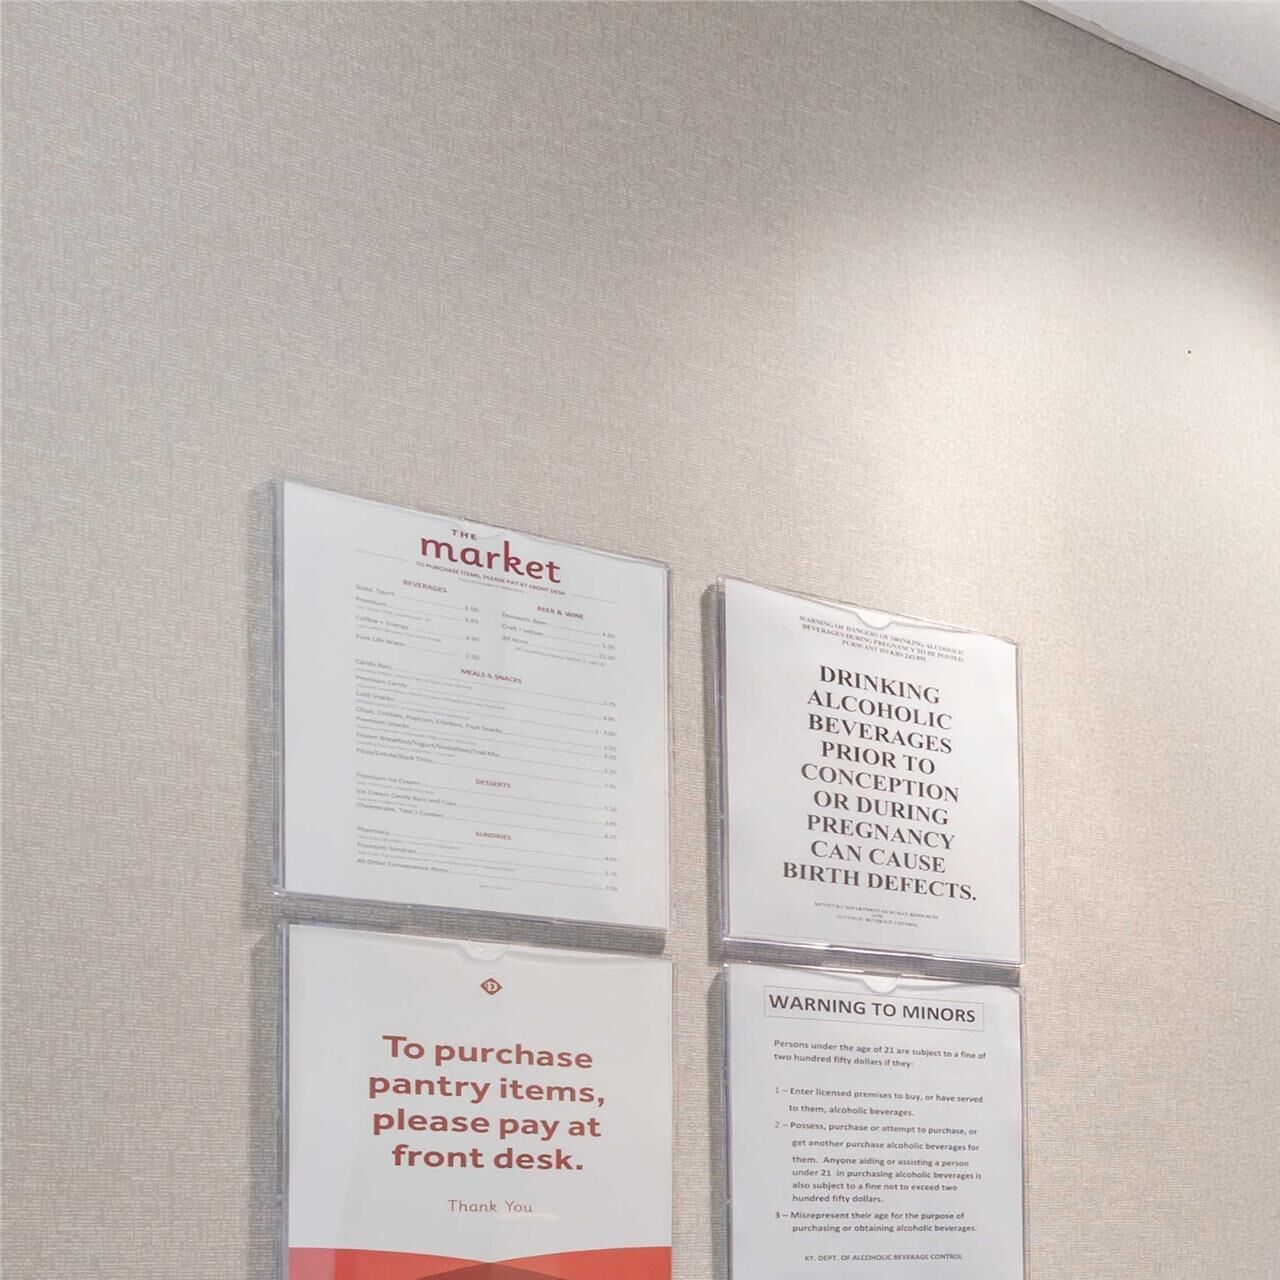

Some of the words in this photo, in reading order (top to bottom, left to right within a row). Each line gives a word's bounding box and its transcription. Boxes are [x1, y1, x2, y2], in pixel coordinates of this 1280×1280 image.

[451, 529, 478, 540] THE
[421, 538, 561, 583] market
[403, 579, 447, 593] BEVERAGES
[461, 669, 485, 678] MEALS
[495, 675, 522, 684] SNACKS
[819, 665, 940, 703] DRINKING
[807, 690, 953, 730] ALCOHOLIC
[808, 713, 953, 754] BEVERAGES
[822, 741, 896, 769] PRIOR
[903, 756, 935, 774] TO
[475, 779, 511, 788] DESSERTS
[801, 763, 959, 802] CONCEPTION
[813, 790, 849, 811] OR
[857, 796, 949, 825] DURING
[475, 831, 512, 840] SUNDRIES
[807, 814, 955, 849] PREGNANCY
[810, 840, 862, 862] CAN
[868, 848, 946, 873] CAUSE
[783, 862, 860, 886] BIRTH
[867, 872, 977, 901] DEFECTS.
[769, 994, 866, 1015] WARNING
[872, 1003, 896, 1017] TO
[903, 1005, 976, 1023] MINORS
[382, 1035, 425, 1059] To
[435, 1044, 593, 1069] purchase
[774, 1040, 809, 1049] Persons
[811, 1041, 836, 1050] under
[840, 1042, 854, 1051] the
[912, 1048, 941, 1057] subject
[961, 1051, 976, 1059] fine
[369, 1076, 490, 1103] pantry
[500, 1077, 605, 1108] items,
[373, 1109, 490, 1135] please
[500, 1118, 559, 1141] pay
[568, 1115, 601, 1137] at
[392, 1144, 484, 1168] front
[493, 1148, 583, 1170] desk.
[448, 1200, 497, 1213] Thank
[505, 1200, 533, 1213] You
